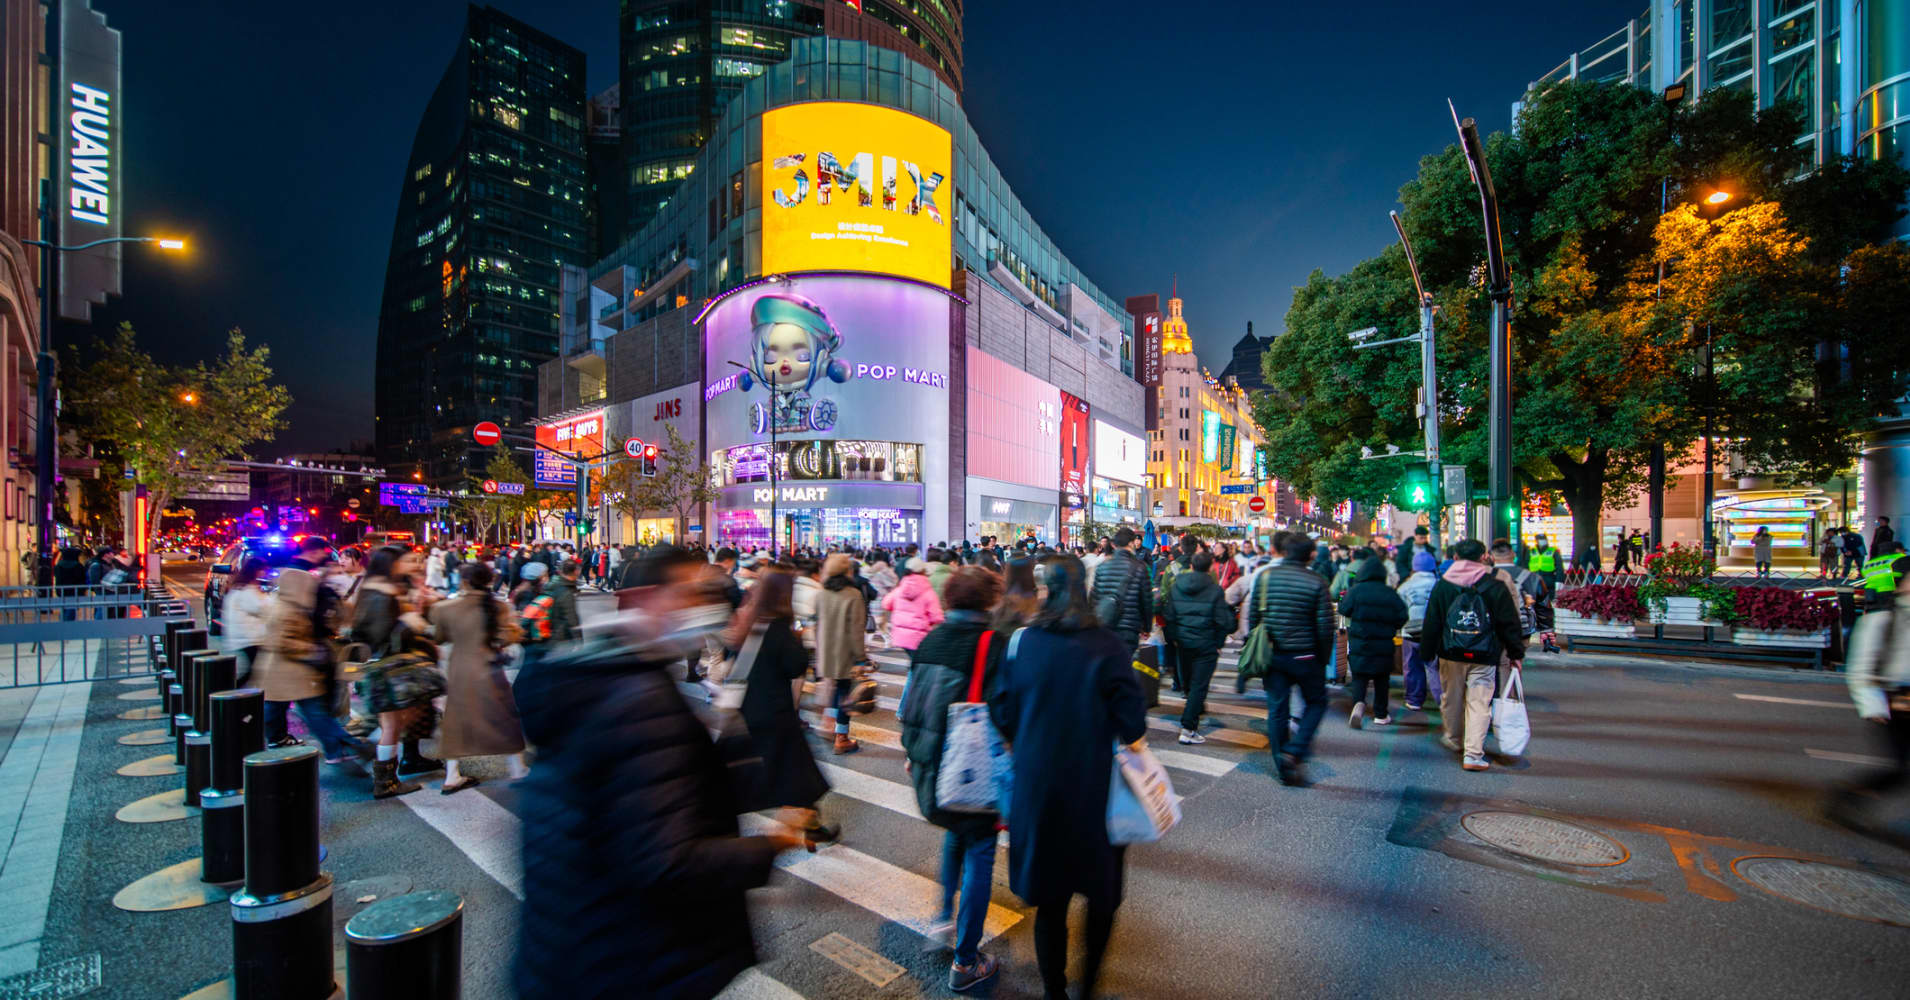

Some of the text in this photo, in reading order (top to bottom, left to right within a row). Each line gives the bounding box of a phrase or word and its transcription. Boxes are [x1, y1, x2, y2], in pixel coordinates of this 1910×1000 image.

[71, 82, 109, 225] HUAWEI
[857, 363, 947, 388] POP MART
[653, 398, 681, 421] JINS
[575, 419, 599, 439] GUYS
[629, 442, 641, 453] 40
[753, 487, 828, 502] POP MART
